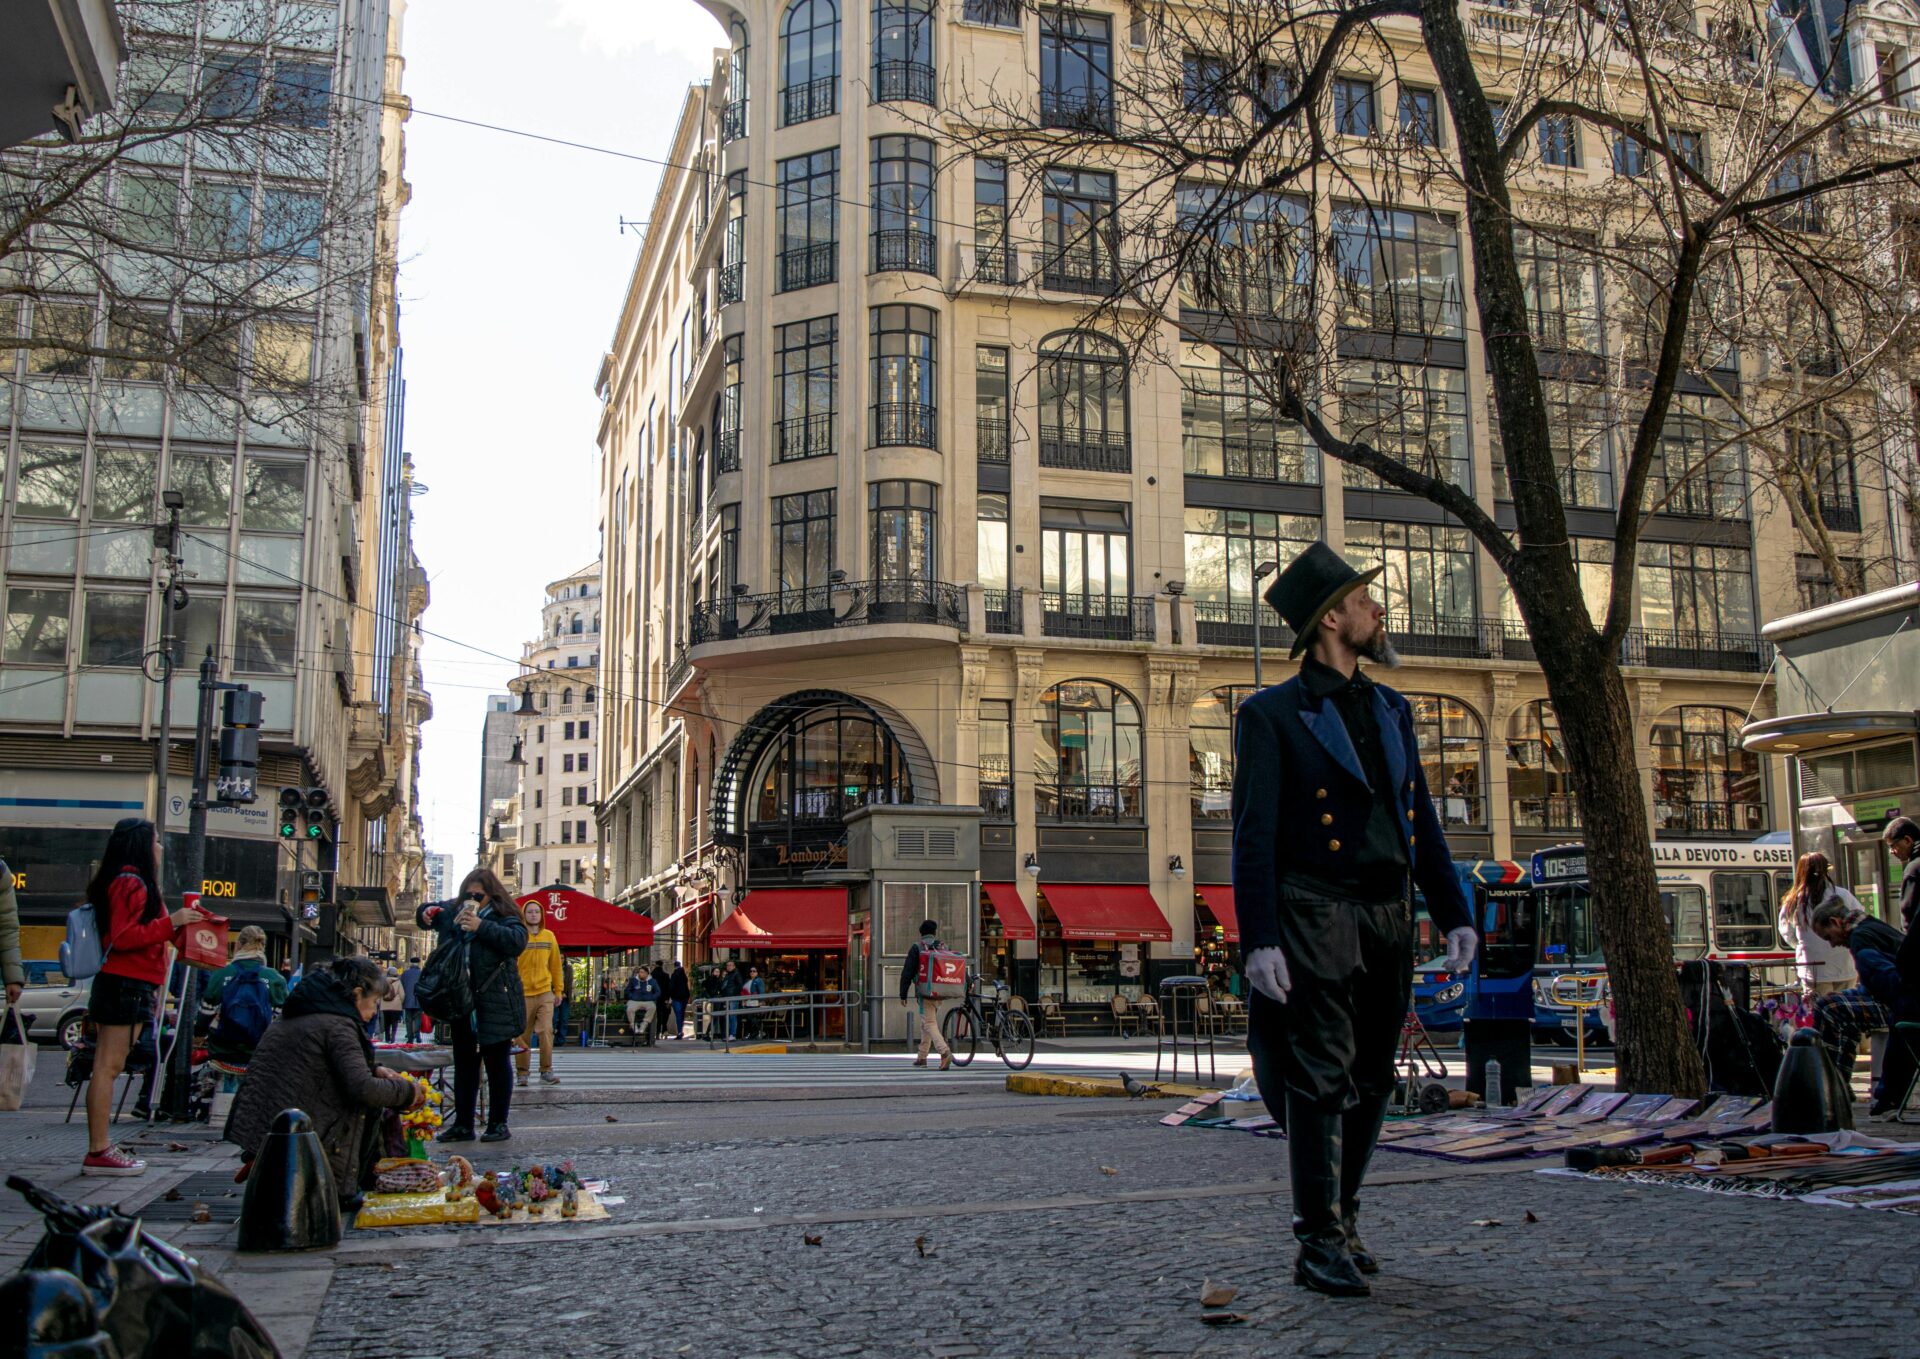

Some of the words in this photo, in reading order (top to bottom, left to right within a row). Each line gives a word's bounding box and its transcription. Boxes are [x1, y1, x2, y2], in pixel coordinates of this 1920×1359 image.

[235, 808, 268, 818] Patronal
[244, 817, 267, 825] Seguros
[776, 844, 827, 865] London
[1651, 847, 1681, 861] ILLA
[1685, 848, 1738, 862] DEVOTO
[1544, 857, 1566, 878] 105
[202, 880, 236, 897] FIORI
